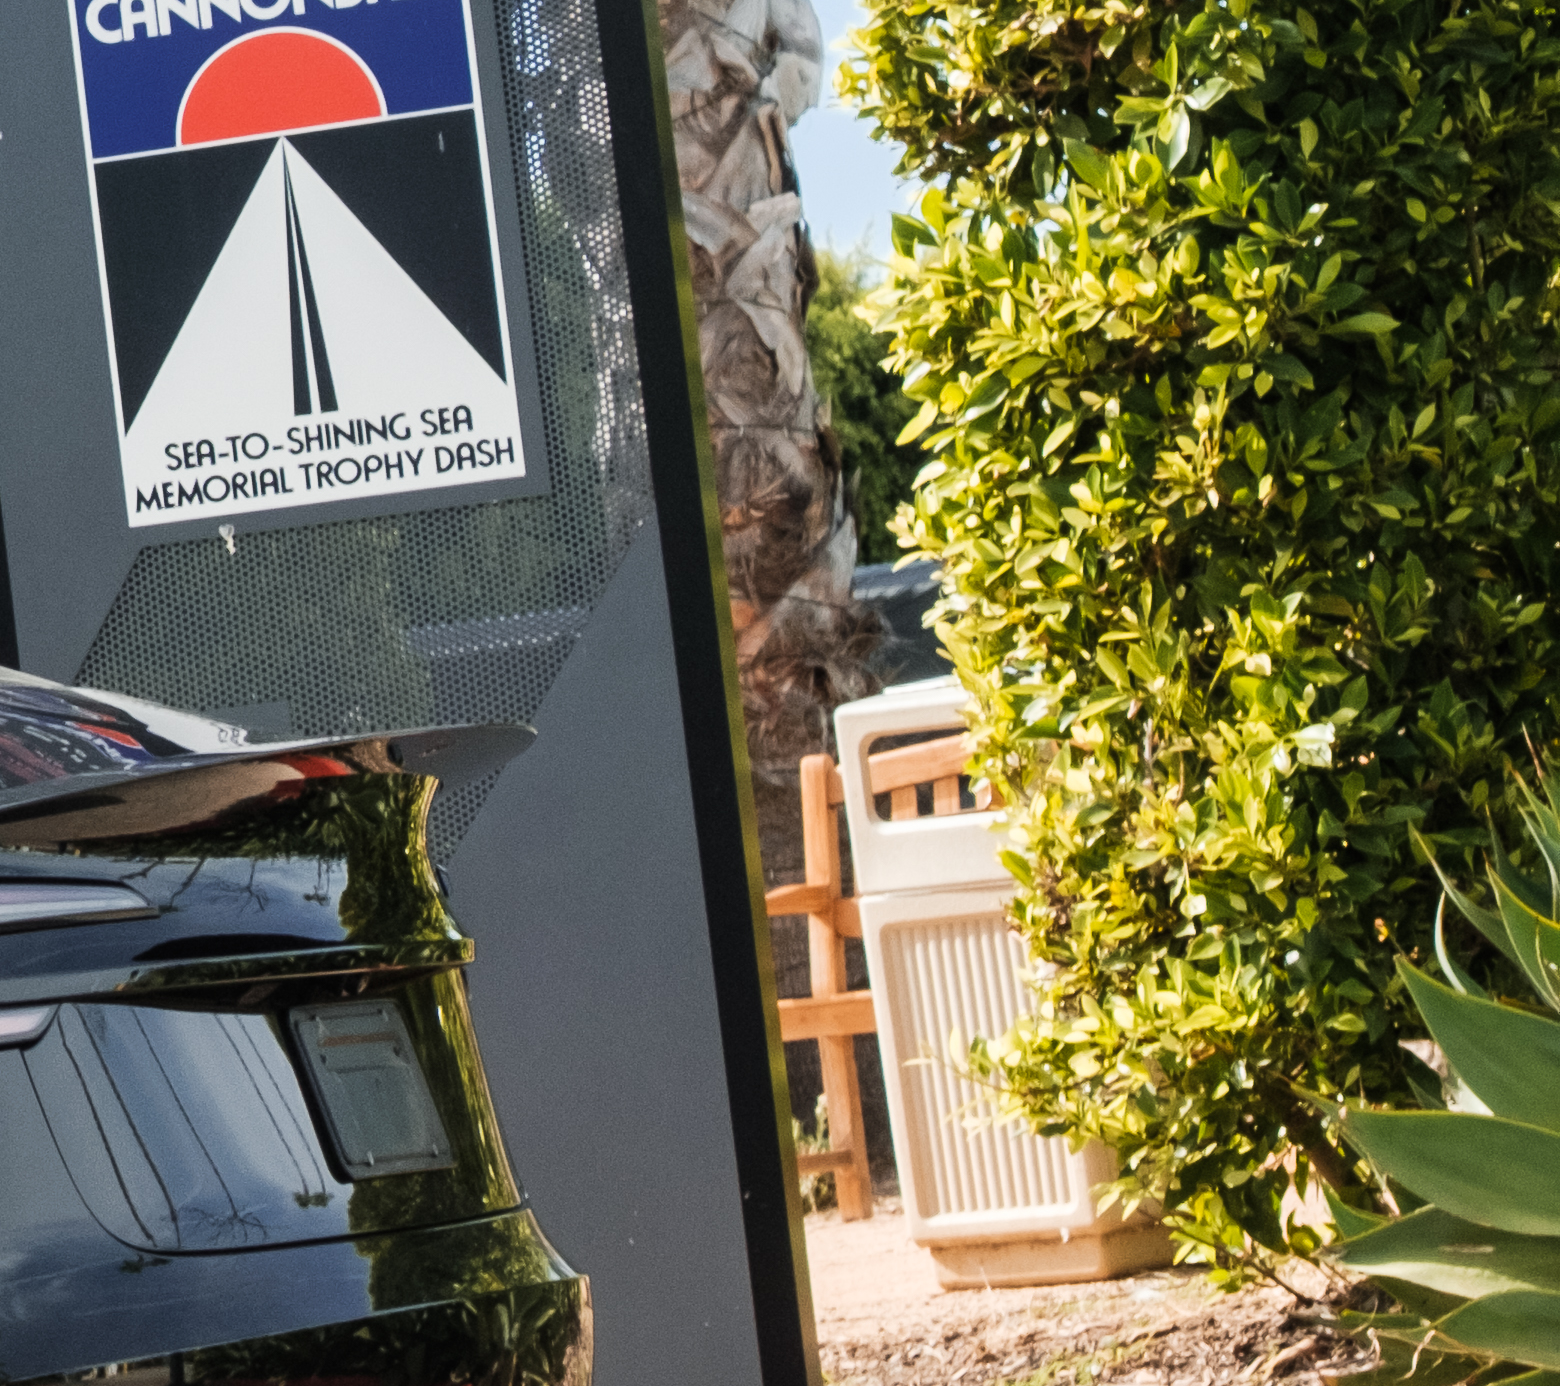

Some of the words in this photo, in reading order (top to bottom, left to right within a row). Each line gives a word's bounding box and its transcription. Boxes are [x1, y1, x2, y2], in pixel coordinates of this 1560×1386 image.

[163, 411, 412, 472] SEA-TO-SHINING
[419, 403, 475, 437] SEA
[134, 465, 294, 513] MEMORIAL
[298, 444, 425, 491] TROPHY
[434, 436, 516, 474] DASH
